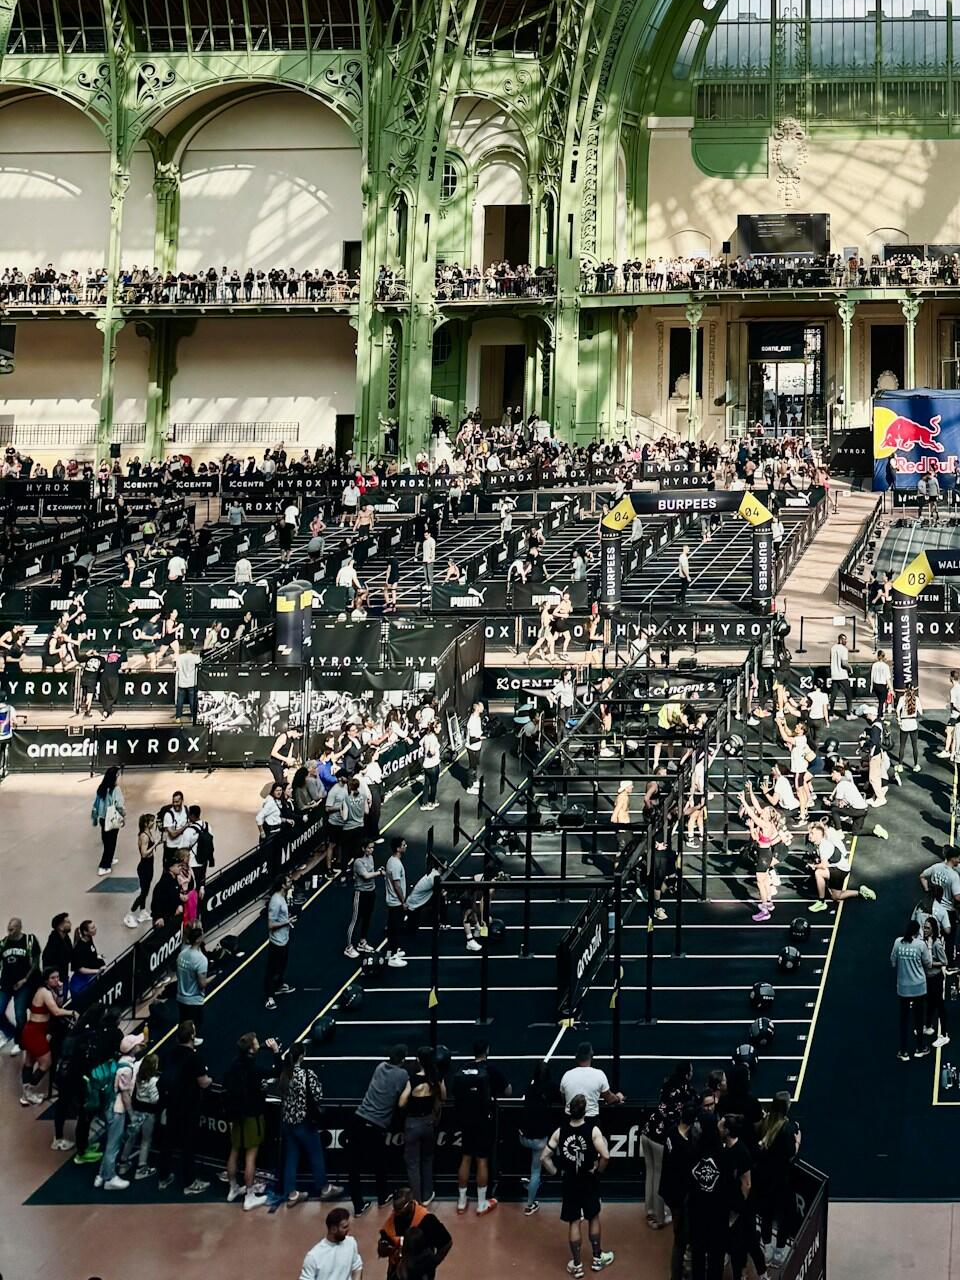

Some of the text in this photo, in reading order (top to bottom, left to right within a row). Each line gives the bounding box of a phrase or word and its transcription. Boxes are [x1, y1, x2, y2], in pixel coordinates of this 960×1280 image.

[897, 457, 928, 473] Red
[278, 479, 322, 488] HYROX
[381, 479, 425, 488] HYROX
[490, 472, 533, 484] HYROX
[663, 475, 708, 486] HYROX
[26, 483, 70, 492] HYROX
[225, 502, 272, 511] HROX
[658, 498, 717, 511] BURPEES
[614, 511, 629, 521] 04
[744, 507, 759, 517] 04
[606, 546, 616, 597] BURPEES
[758, 541, 767, 592] BURPEES
[907, 572, 926, 585] 08
[900, 614, 913, 684] WALL BALLS
[8, 681, 68, 695] YROX
[105, 736, 200, 755] HYROX
[391, 748, 424, 774] CENTR
[221, 868, 260, 899] concept
